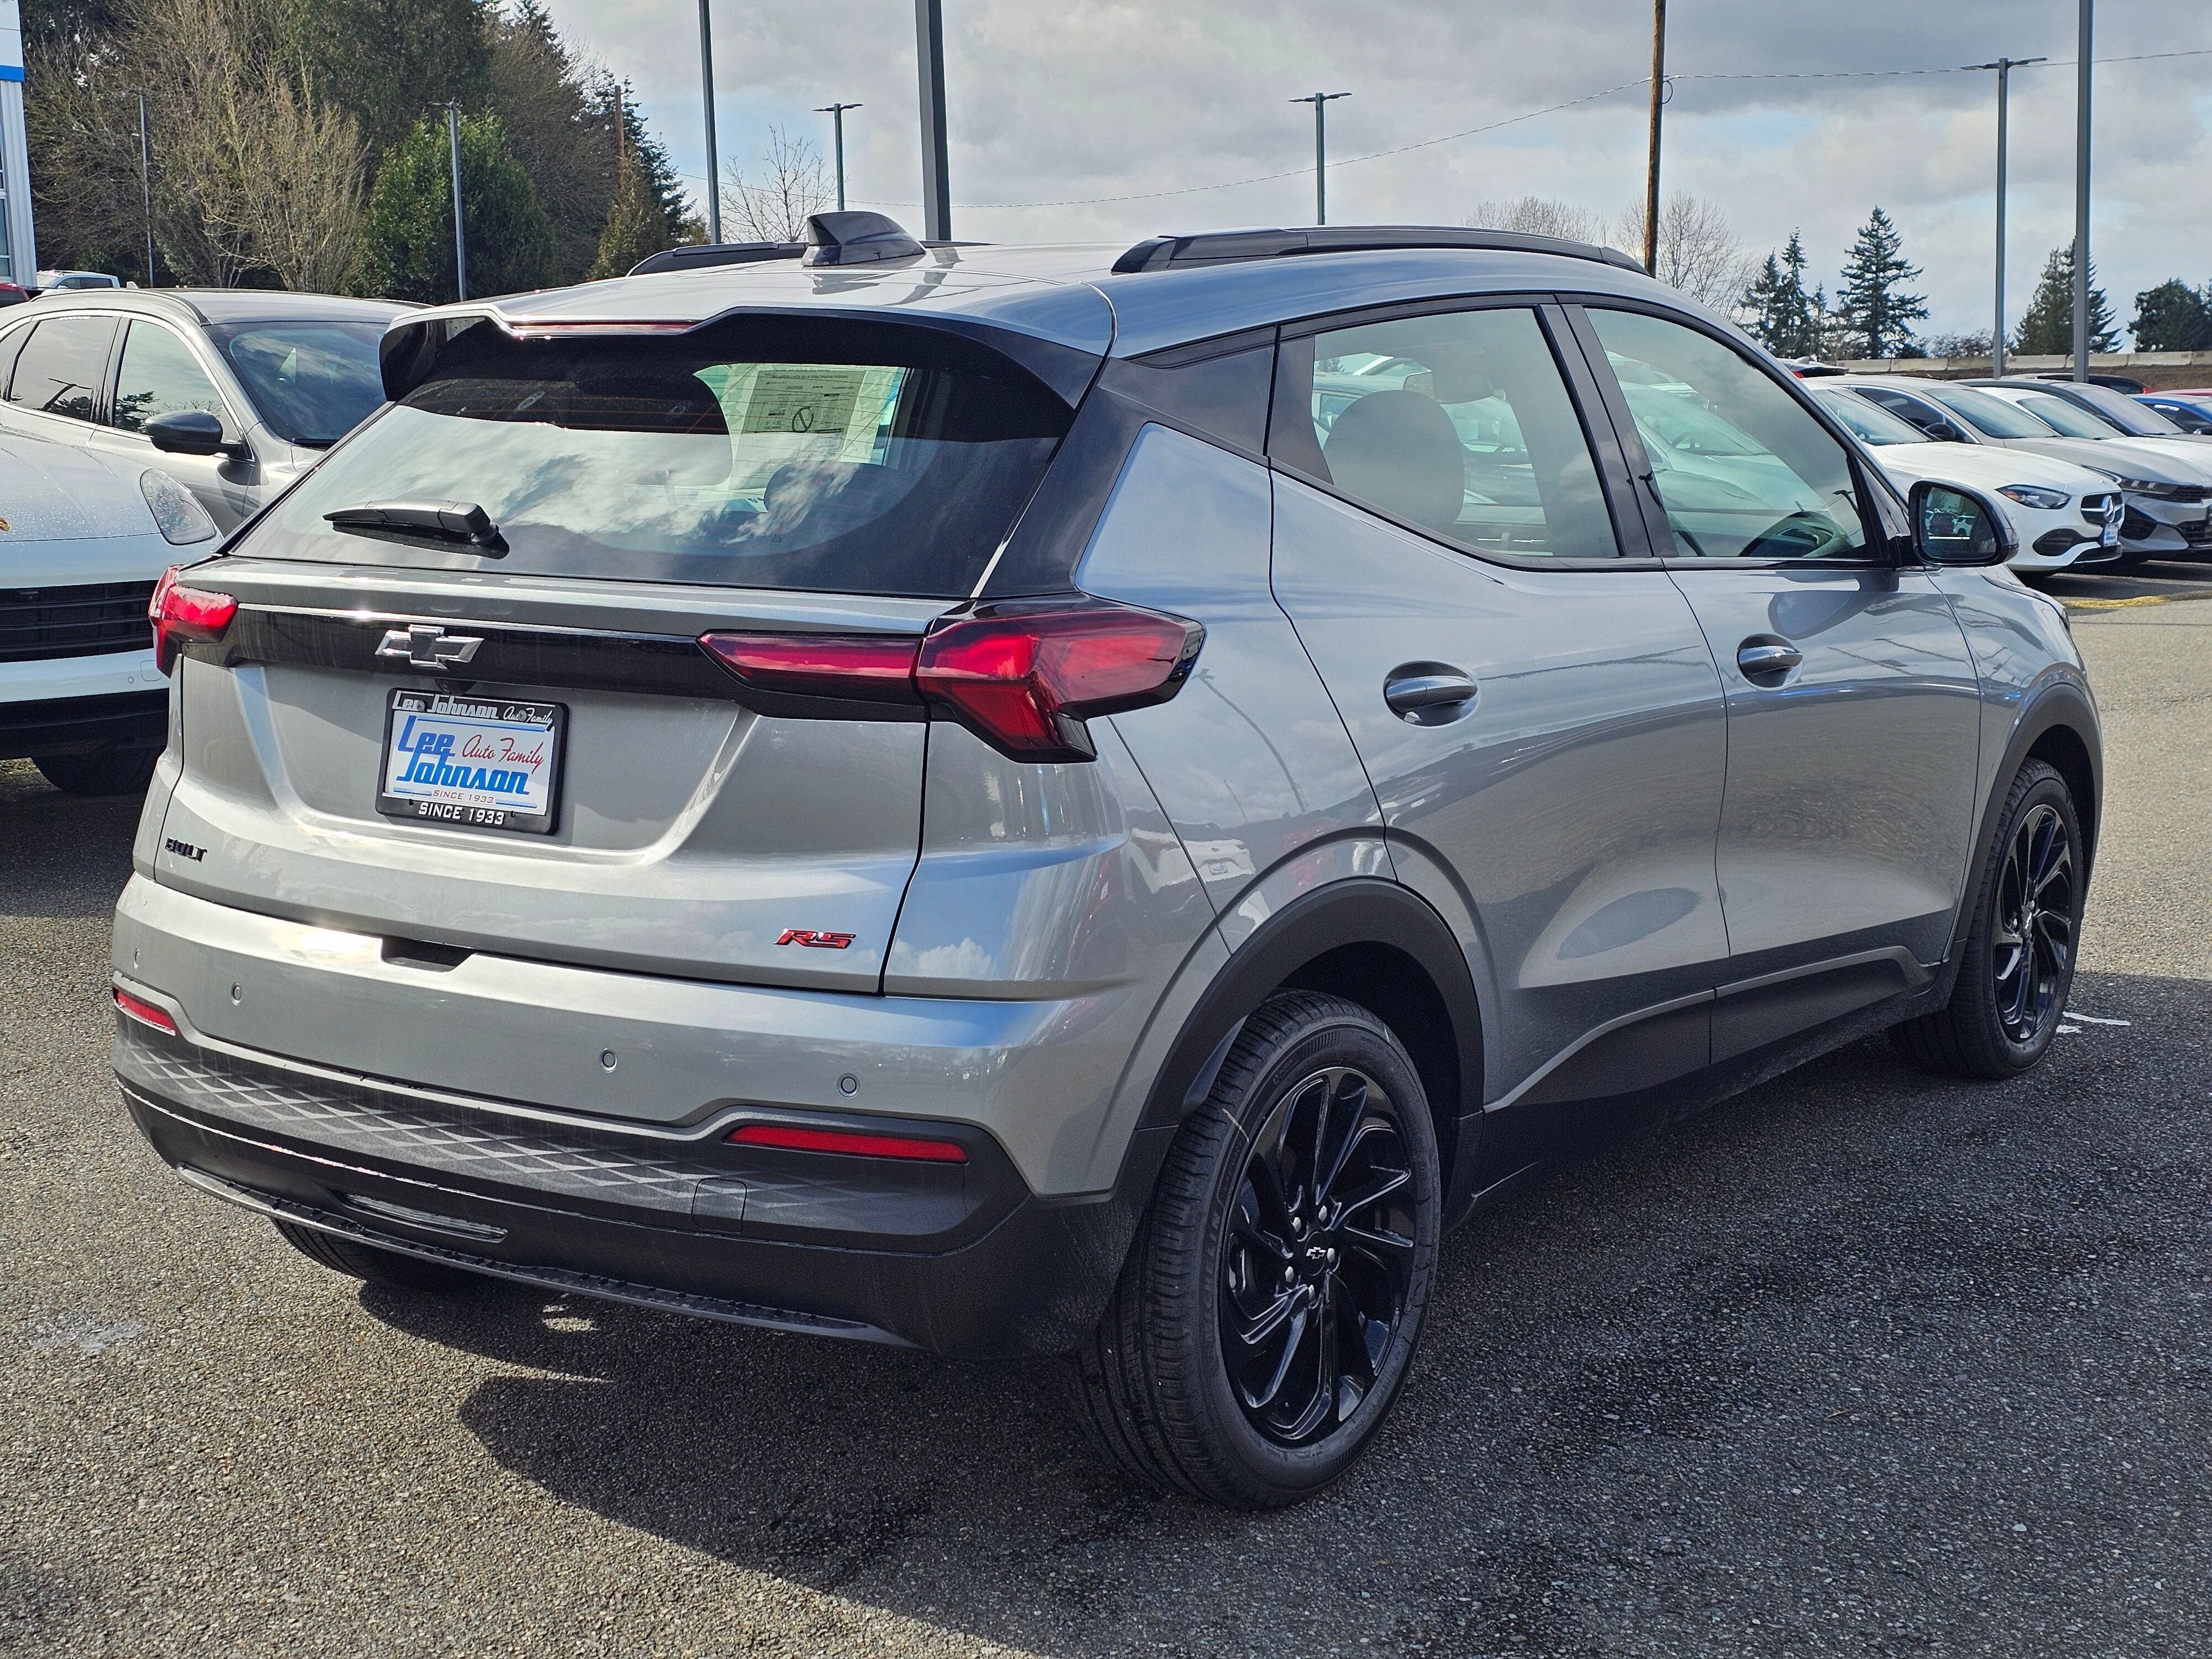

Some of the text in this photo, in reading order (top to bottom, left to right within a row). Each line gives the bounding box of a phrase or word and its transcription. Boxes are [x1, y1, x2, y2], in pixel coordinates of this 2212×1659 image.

[427, 694, 499, 719] Johnson
[503, 706, 526, 721] Au
[525, 707, 554, 731] Family
[398, 716, 455, 756] Lee
[462, 734, 544, 775] Auto Family
[396, 750, 530, 795] Johnson
[433, 790, 494, 804] SINCE 1933
[419, 802, 504, 825] SINCE 1933
[165, 838, 207, 863] BOLT
[773, 928, 856, 949] RS
